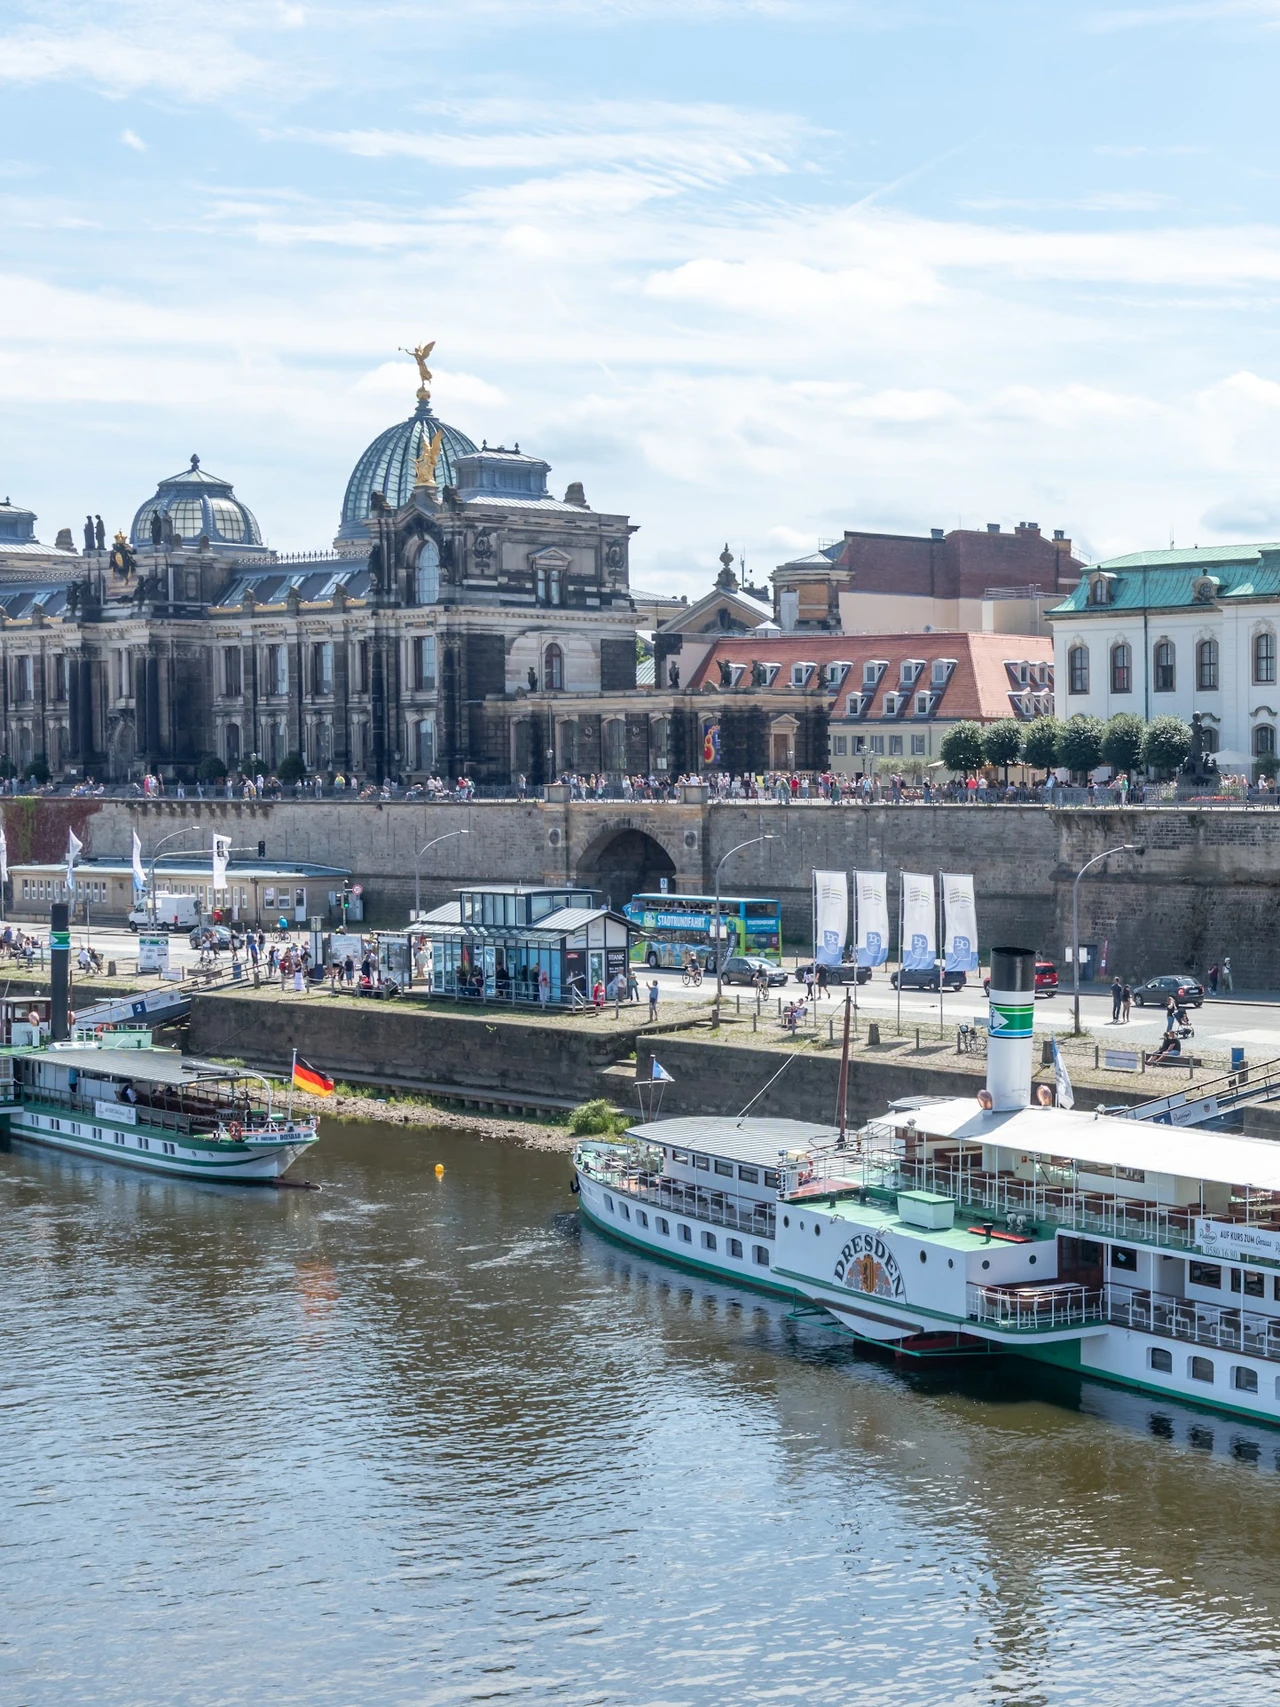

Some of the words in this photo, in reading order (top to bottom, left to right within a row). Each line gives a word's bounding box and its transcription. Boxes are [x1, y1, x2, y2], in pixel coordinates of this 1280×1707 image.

[657, 915, 706, 928] STADTRUNDFAHRT
[135, 1004, 142, 1012] 2
[1220, 1230, 1230, 1239] AUF
[1230, 1232, 1243, 1242] KURS
[1244, 1234, 1255, 1244] ZUM
[1221, 1248, 1228, 1258] 16
[1229, 1250, 1238, 1260] 80
[834, 1234, 904, 1298] DRESDEN
